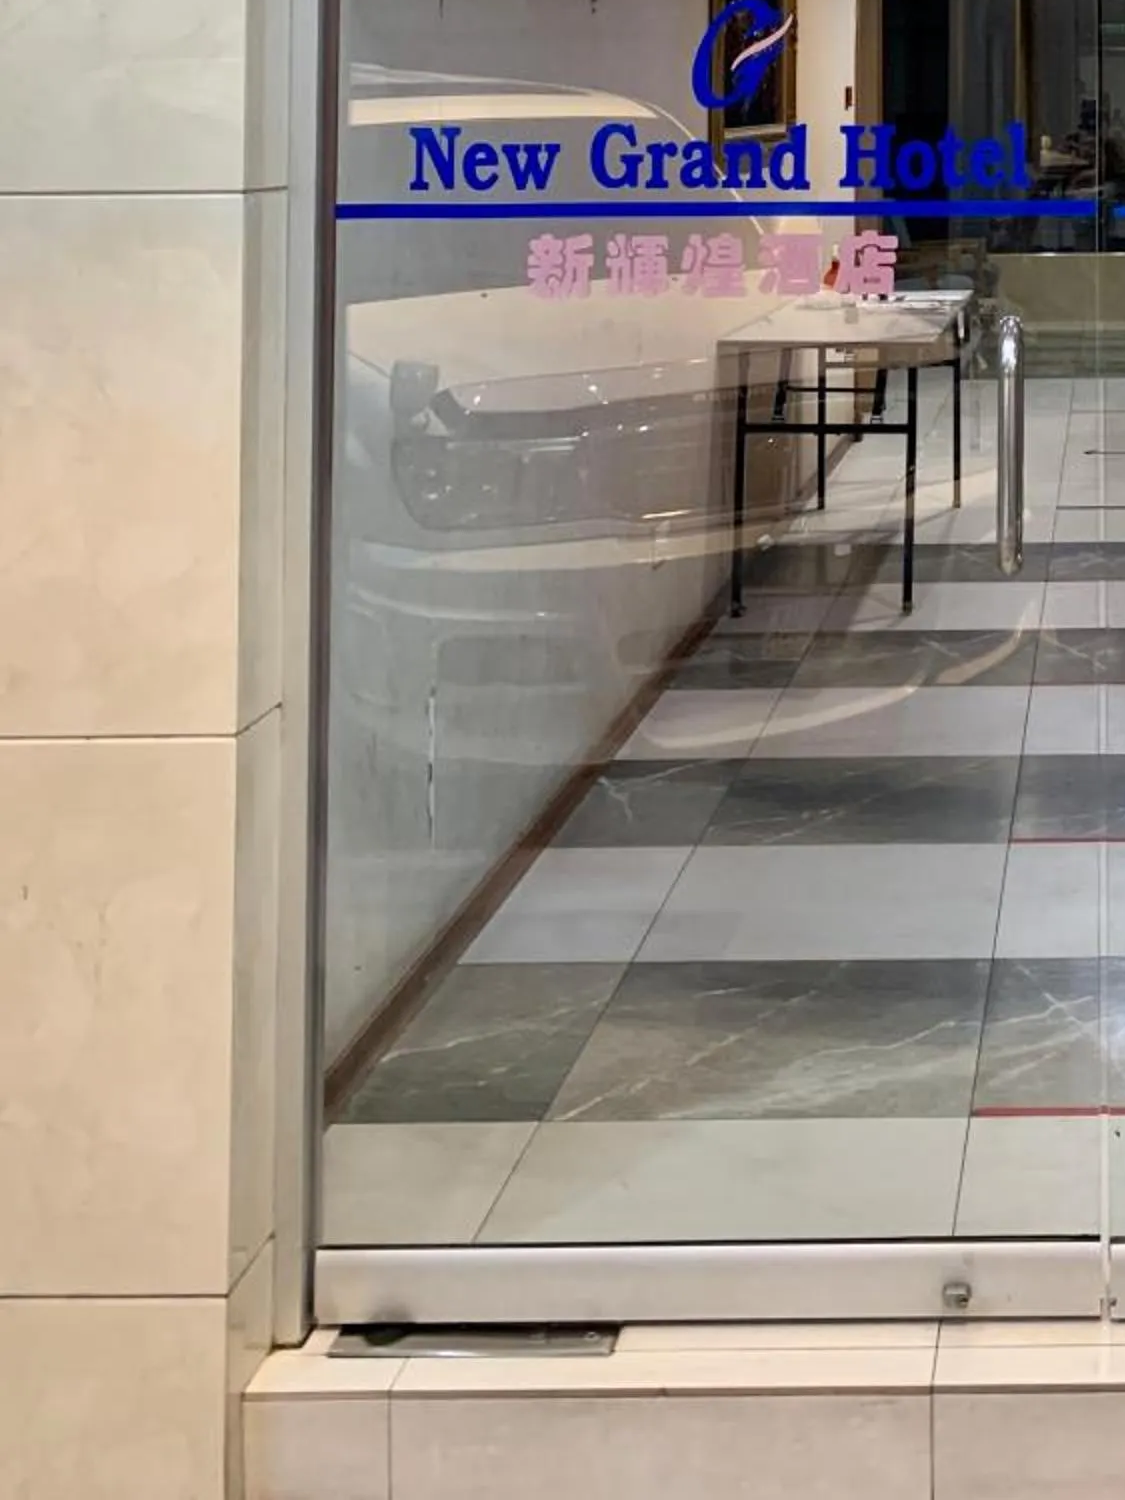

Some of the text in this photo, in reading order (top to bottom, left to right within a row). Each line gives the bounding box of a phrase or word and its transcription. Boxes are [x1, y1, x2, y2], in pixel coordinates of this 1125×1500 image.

[409, 121, 1031, 191] New Grand Hotel
[527, 231, 899, 300] 新輝煌酒店
